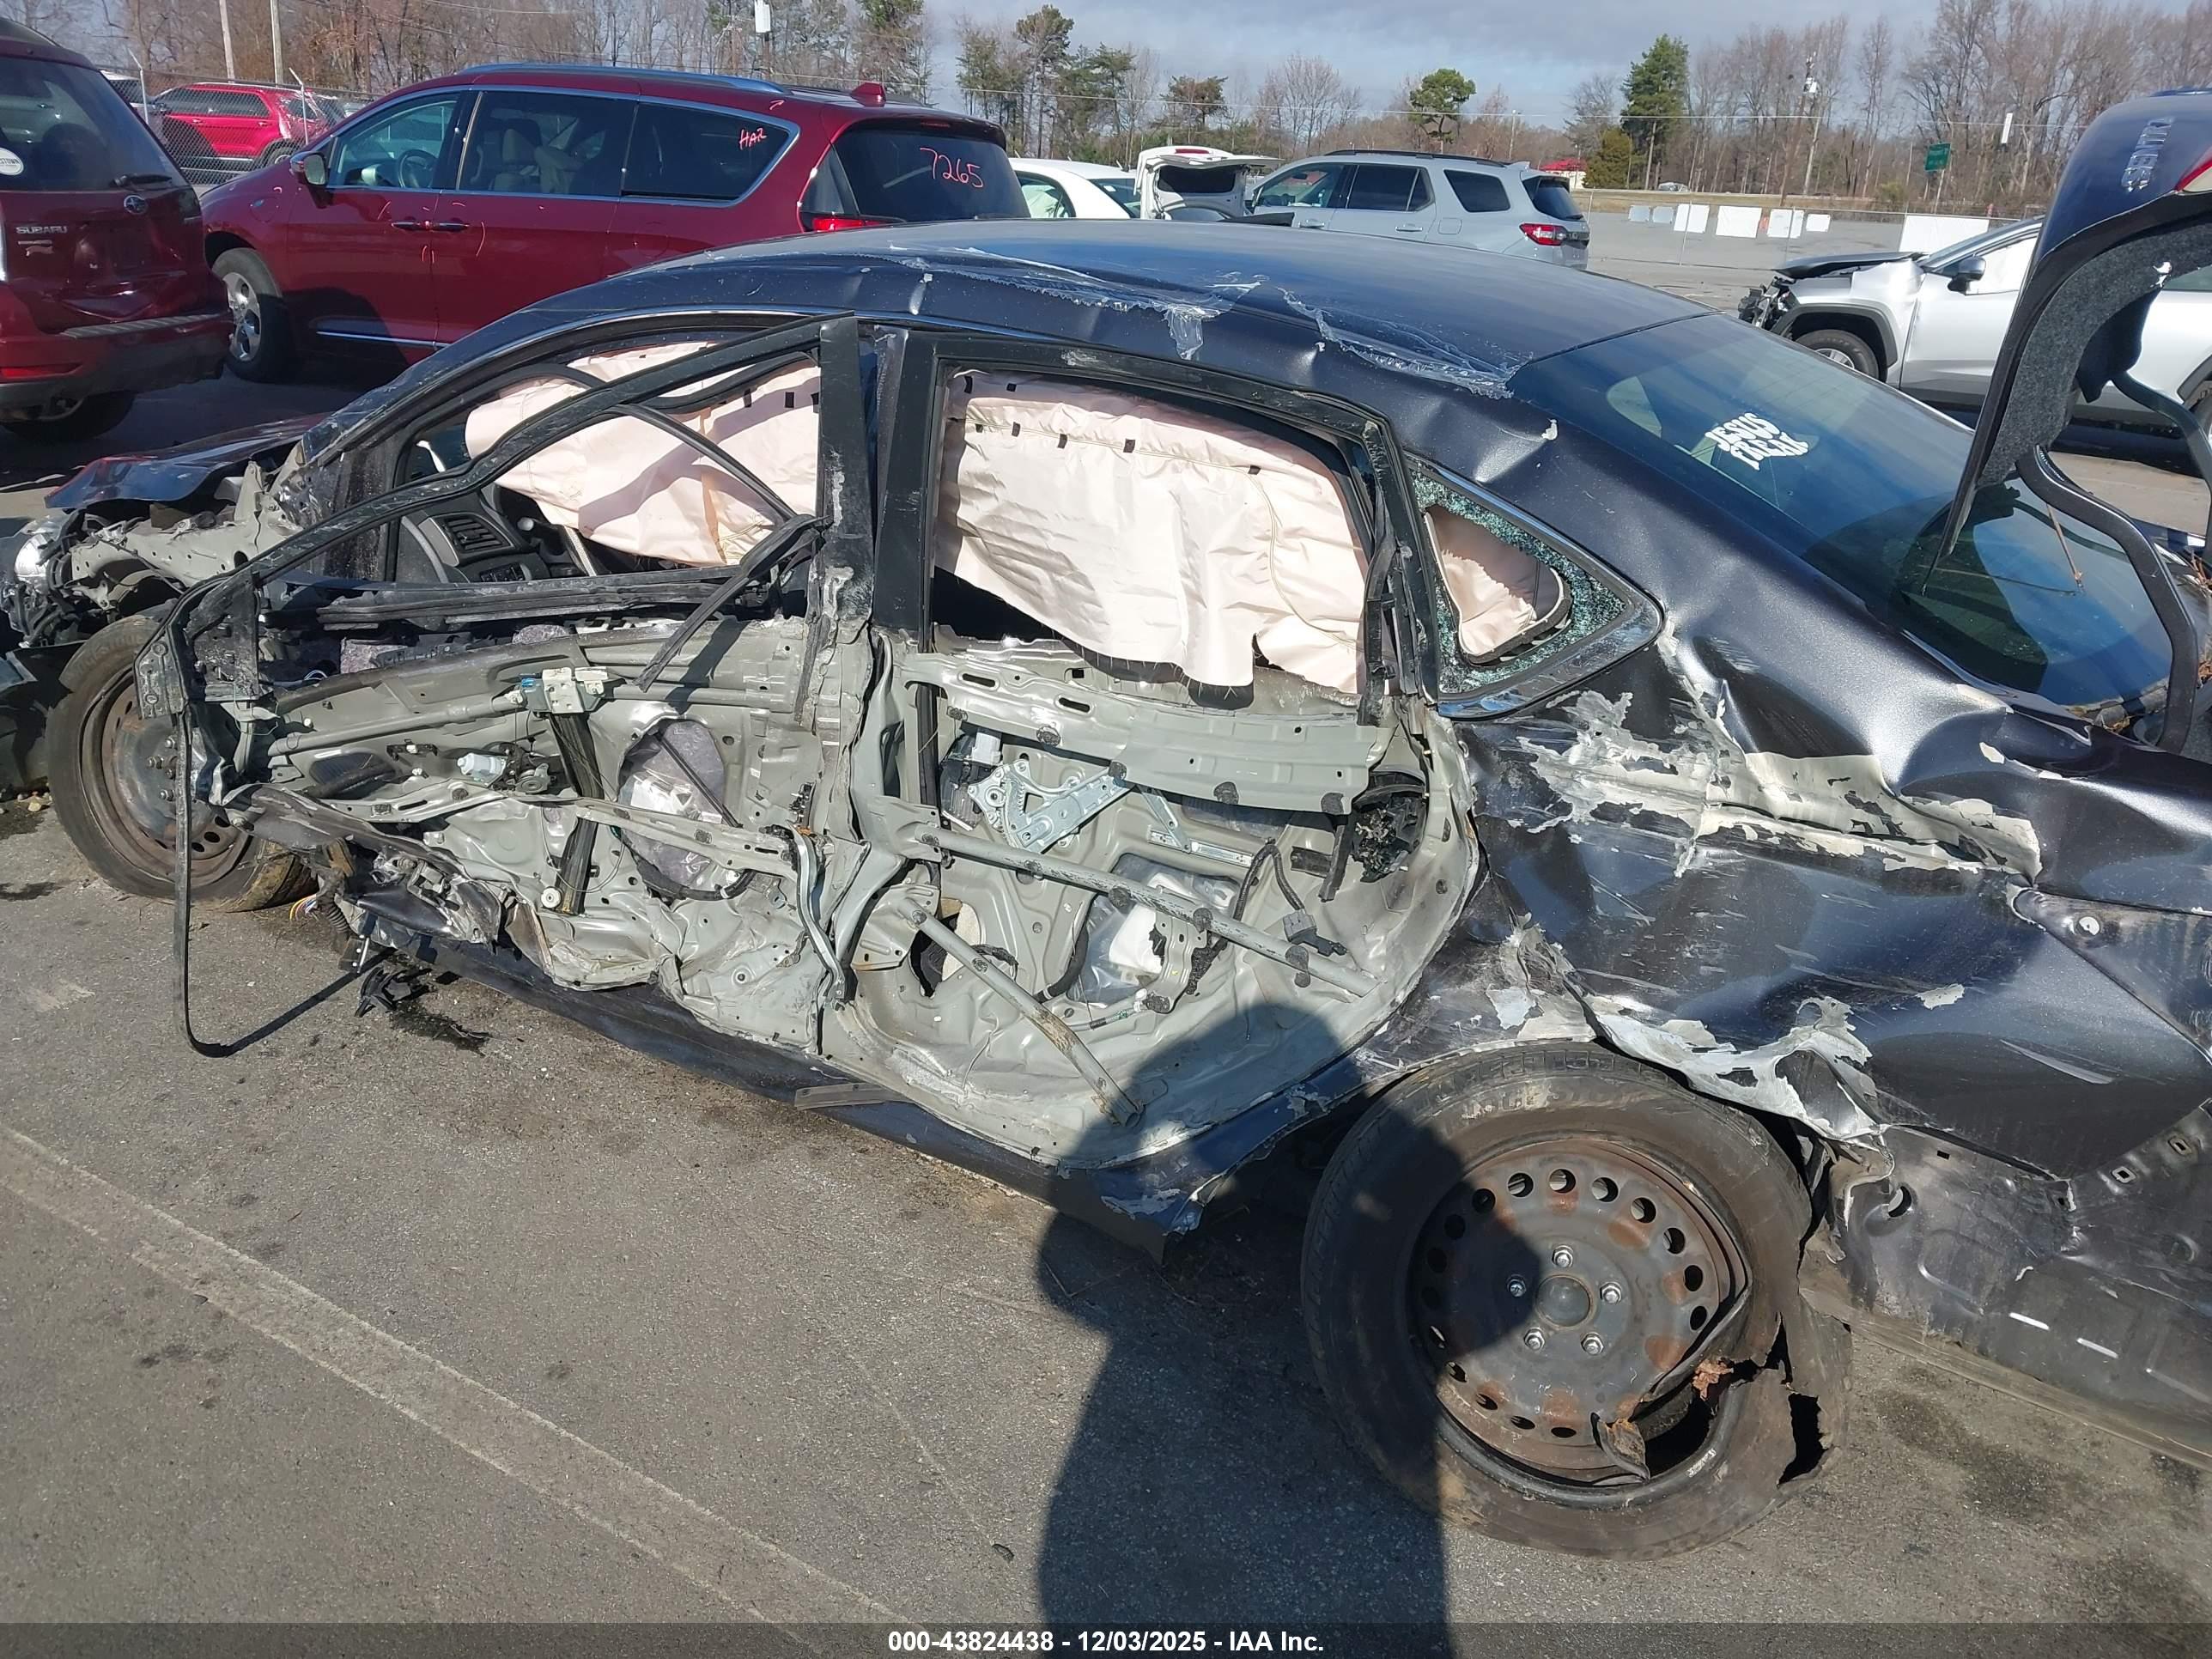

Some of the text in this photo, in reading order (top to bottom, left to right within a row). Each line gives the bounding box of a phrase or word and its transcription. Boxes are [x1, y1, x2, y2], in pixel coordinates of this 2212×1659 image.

[920, 147, 983, 187] 7265
[16, 226, 68, 234] SUBARU
[1705, 410, 1780, 452] JESUS
[1730, 431, 1808, 471] FREAK
